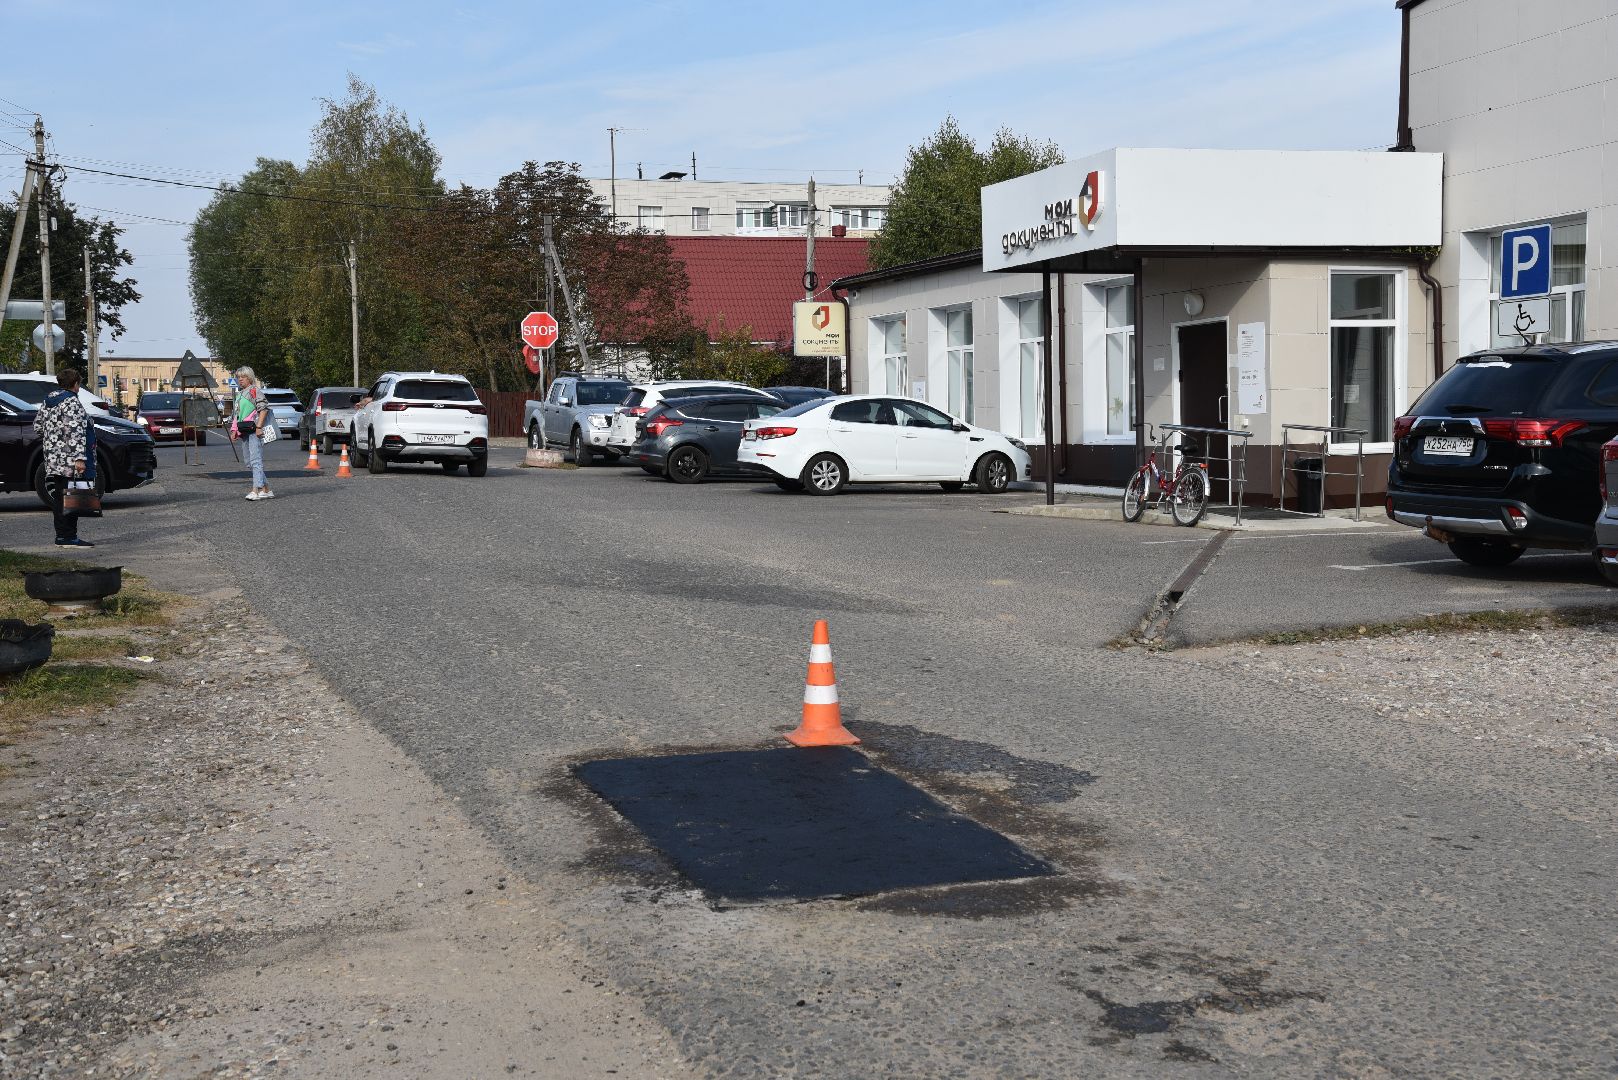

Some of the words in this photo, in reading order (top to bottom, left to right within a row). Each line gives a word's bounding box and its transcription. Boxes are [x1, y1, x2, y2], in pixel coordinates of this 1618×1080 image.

[1002, 219, 1072, 254] документы
[1512, 235, 1539, 291] P
[524, 325, 556, 336] STOP
